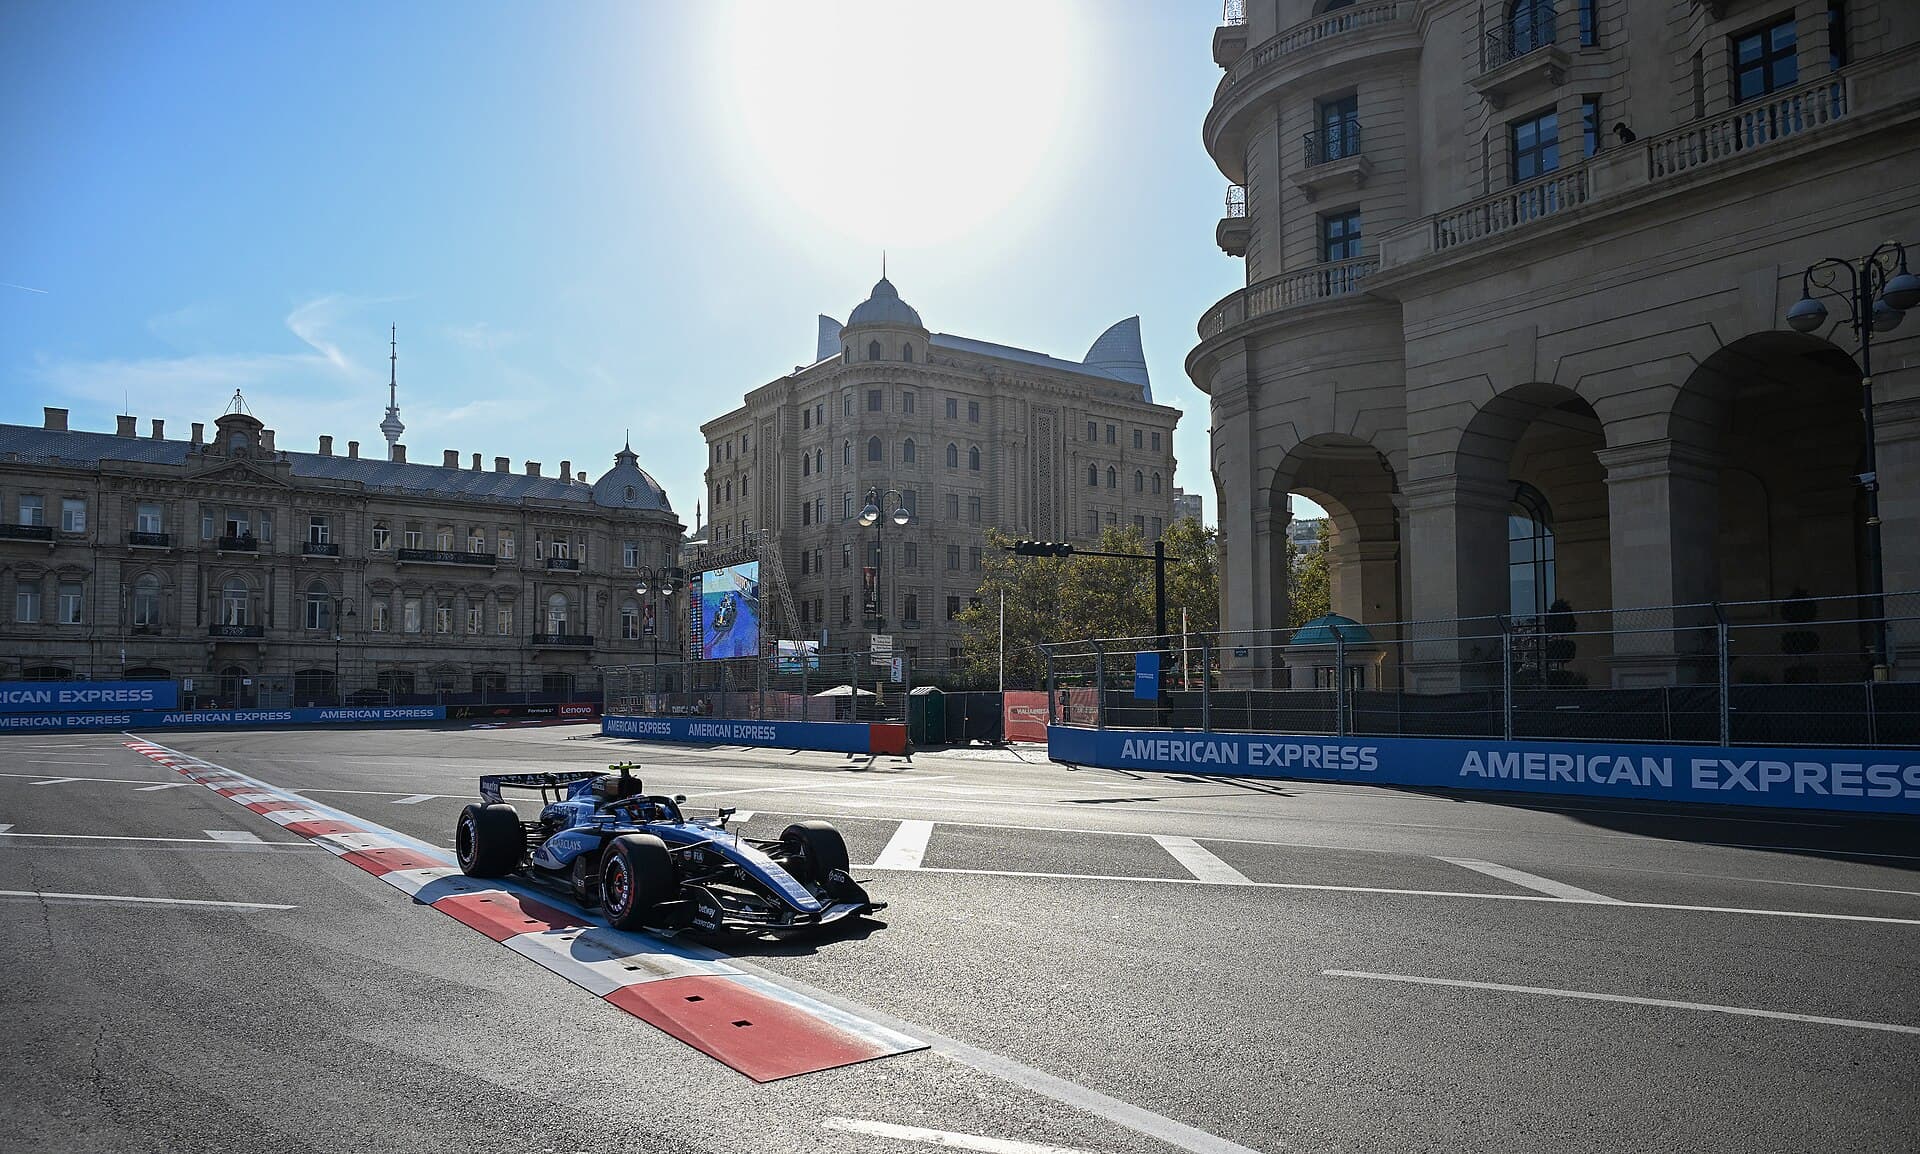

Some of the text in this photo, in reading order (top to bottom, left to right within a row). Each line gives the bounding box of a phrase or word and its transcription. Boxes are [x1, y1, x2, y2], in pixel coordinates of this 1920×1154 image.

[59, 689, 153, 703] EXPRESS
[162, 711, 292, 723] AMERICAN EXPRESS
[319, 708, 434, 719] AMERICAN EXPRESS
[561, 706, 592, 714] Lenovo
[66, 715, 130, 726] EXPRESS
[607, 720, 671, 735] AMERICAN EXPRESS
[688, 723, 776, 740] AMERICAN EXPRESS
[1121, 738, 1379, 772] AMERICAN EXPRESS
[1459, 750, 1673, 787] AMERICAN
